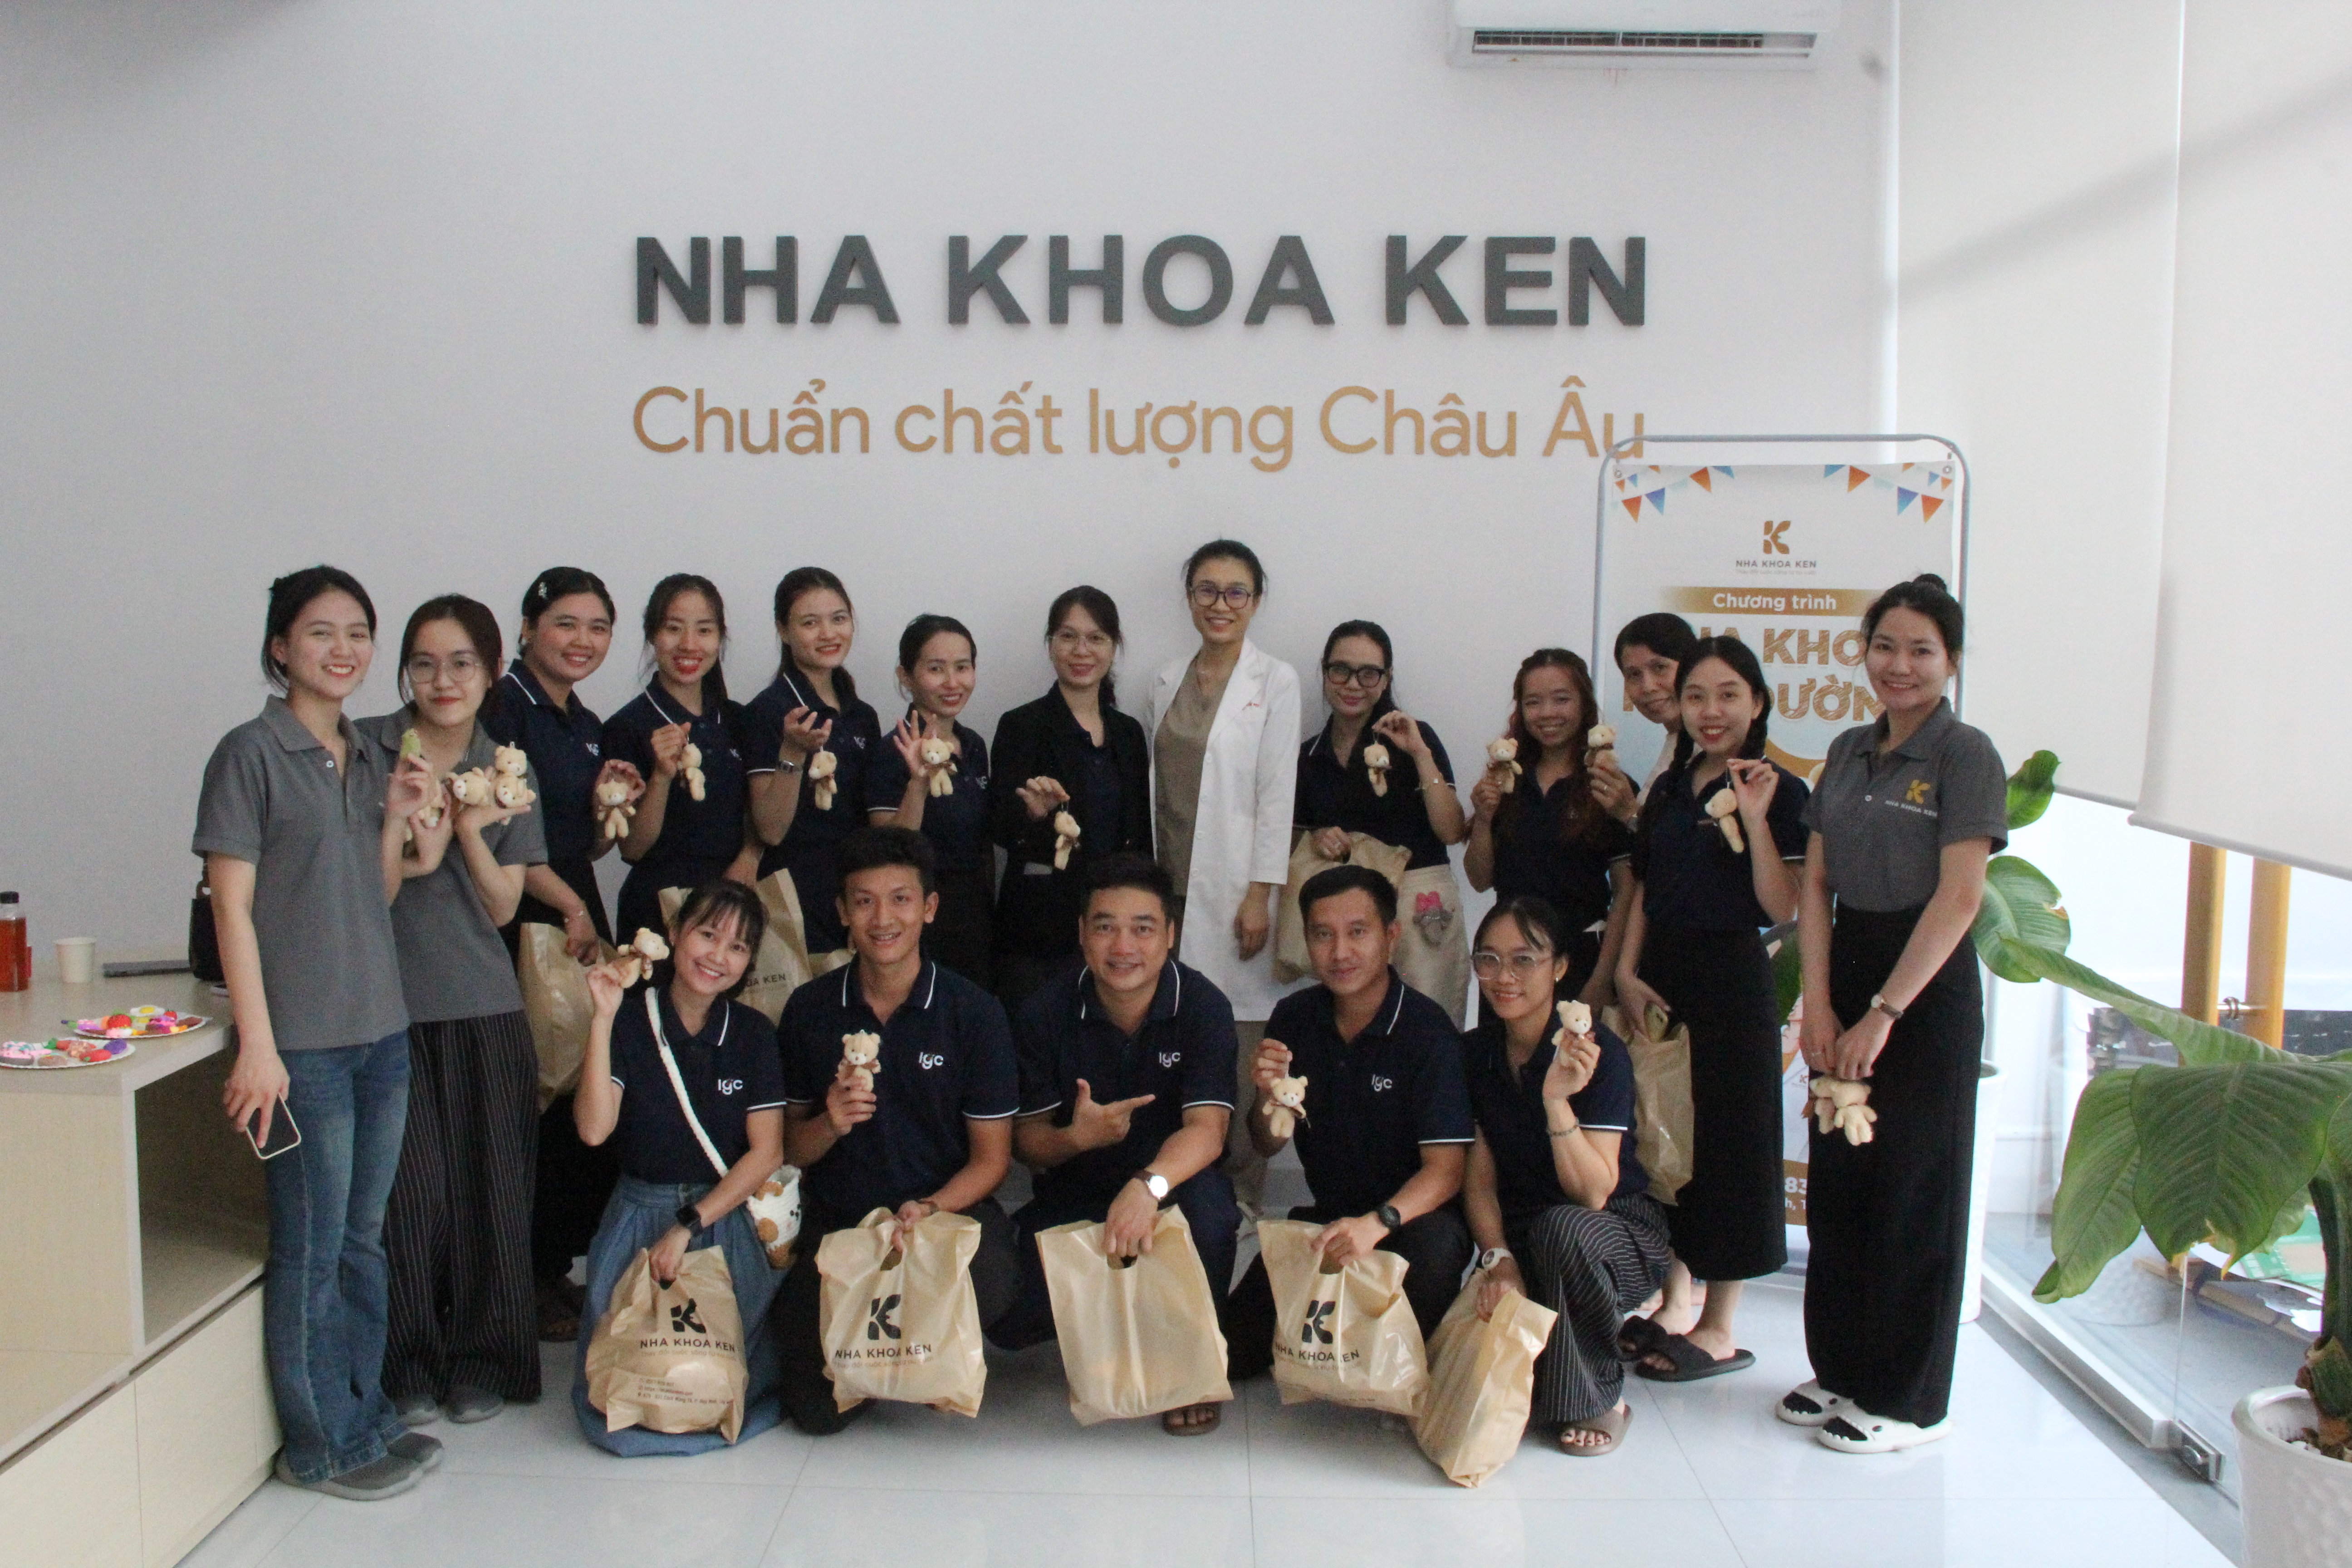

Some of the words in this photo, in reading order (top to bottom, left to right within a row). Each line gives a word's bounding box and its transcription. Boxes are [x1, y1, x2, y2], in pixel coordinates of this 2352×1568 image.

[637, 235, 901, 326] NHA
[948, 235, 1335, 326] KHOA
[1385, 235, 1646, 326] KEN
[633, 378, 870, 455] Chuẩn
[895, 381, 1063, 455] chất
[1090, 388, 1294, 472] lượng
[1320, 386, 1517, 458] Châu
[1542, 375, 1644, 459] Âu
[1713, 593, 1785, 612] Chương
[1792, 593, 1837, 610] trình
[1763, 628, 1867, 666] KHO
[763, 973, 786, 984] KEN
[640, 1338, 668, 1348] NHA
[674, 1338, 711, 1348] KHOA
[715, 1340, 735, 1352] KEN
[835, 1349, 861, 1359] NHA
[906, 1344, 932, 1356] KEN
[1298, 1350, 1335, 1361] KHOA
[1341, 1349, 1360, 1363] EN
